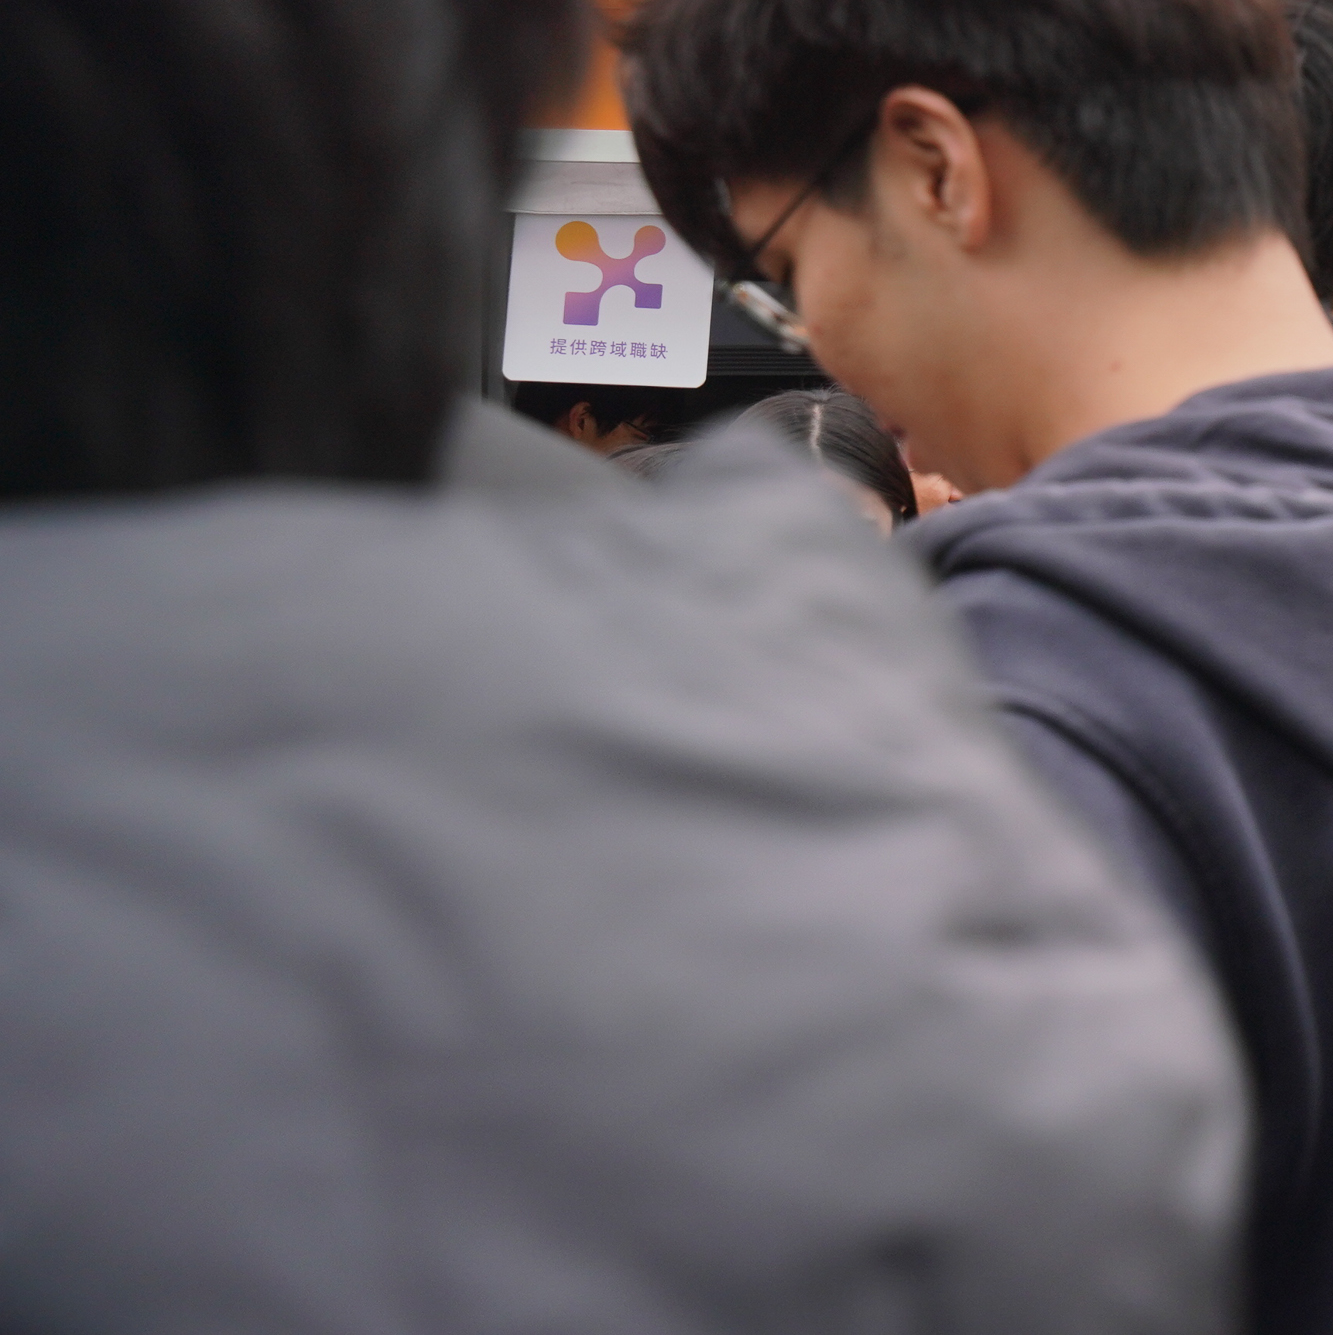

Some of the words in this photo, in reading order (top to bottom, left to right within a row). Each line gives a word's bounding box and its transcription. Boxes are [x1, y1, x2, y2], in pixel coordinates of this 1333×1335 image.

[550, 338, 668, 359] 提供跨域職缺
